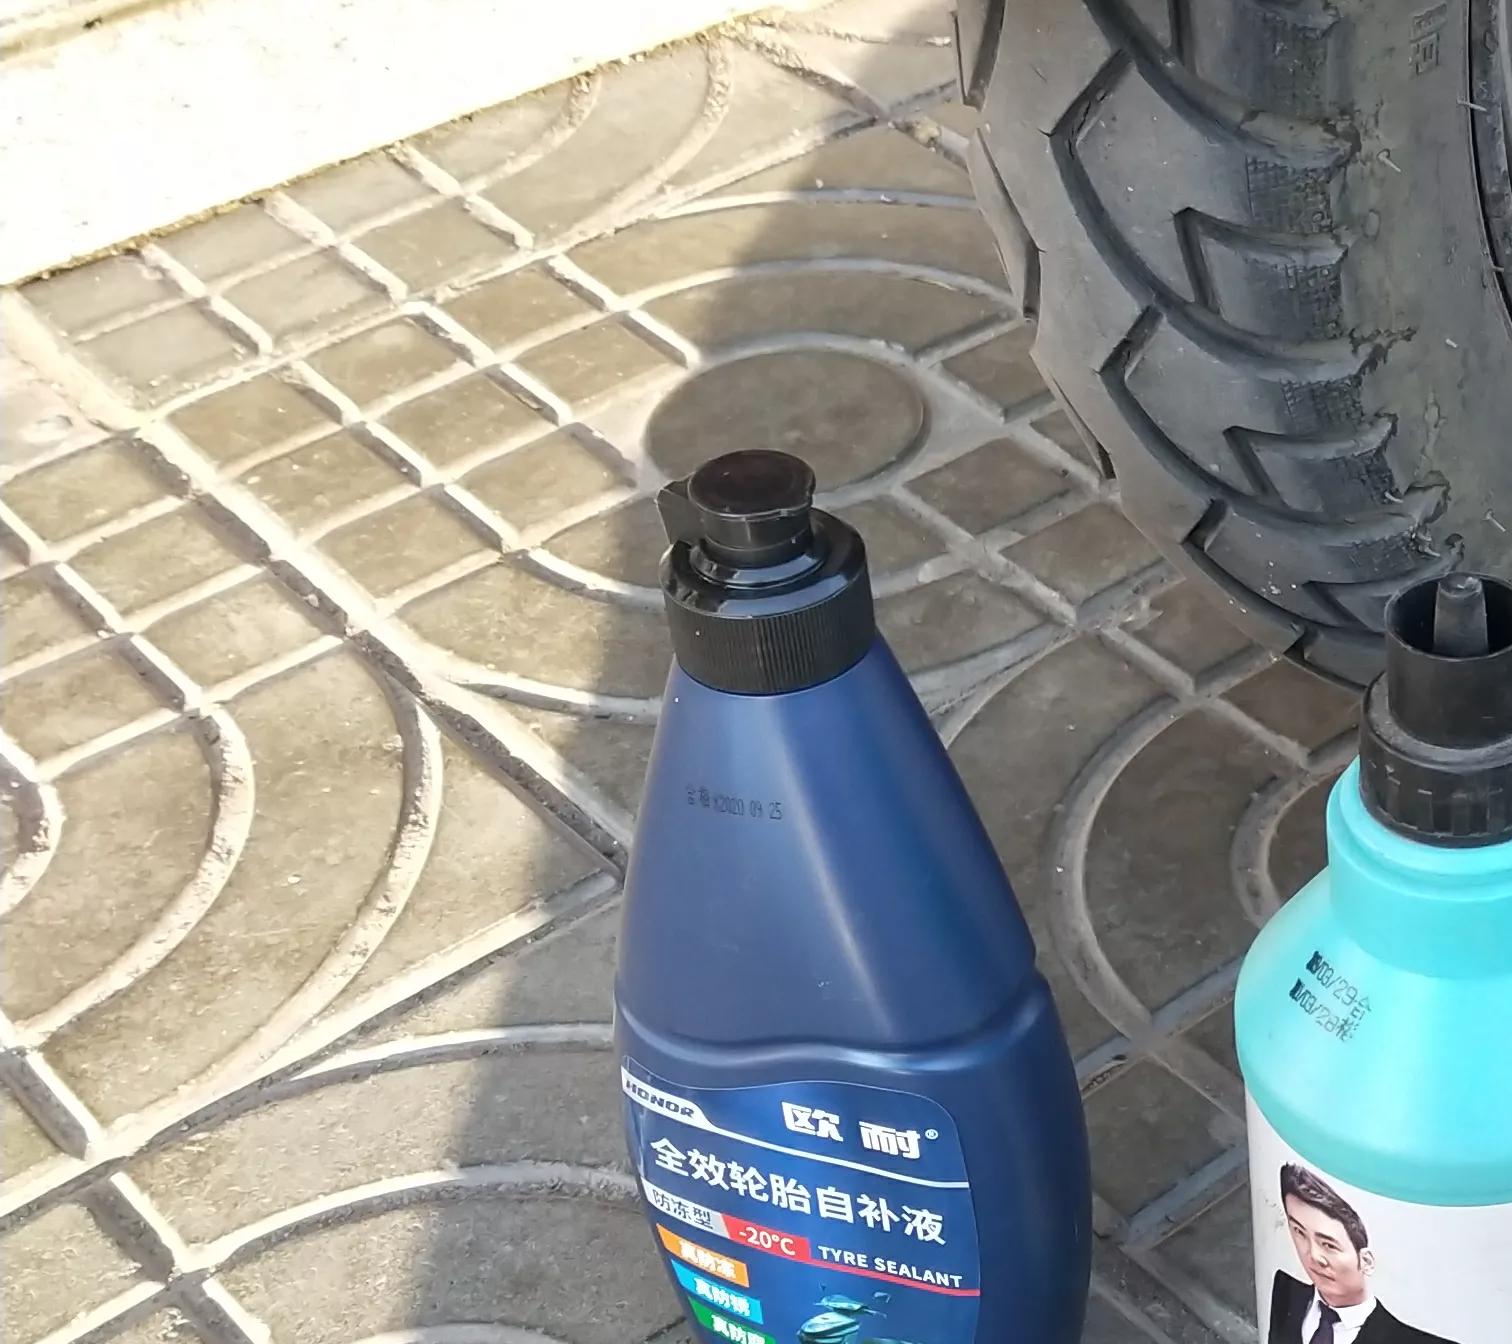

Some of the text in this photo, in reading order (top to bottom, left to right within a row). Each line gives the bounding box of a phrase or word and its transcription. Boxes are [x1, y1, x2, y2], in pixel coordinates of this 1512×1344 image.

[625, 1079, 695, 1120] HONOR
[650, 1137, 946, 1245] 全效轮胎自补液
[653, 1189, 714, 1230] 防冻型
[739, 1226, 963, 1288] -20°C TYRE SEALANT
